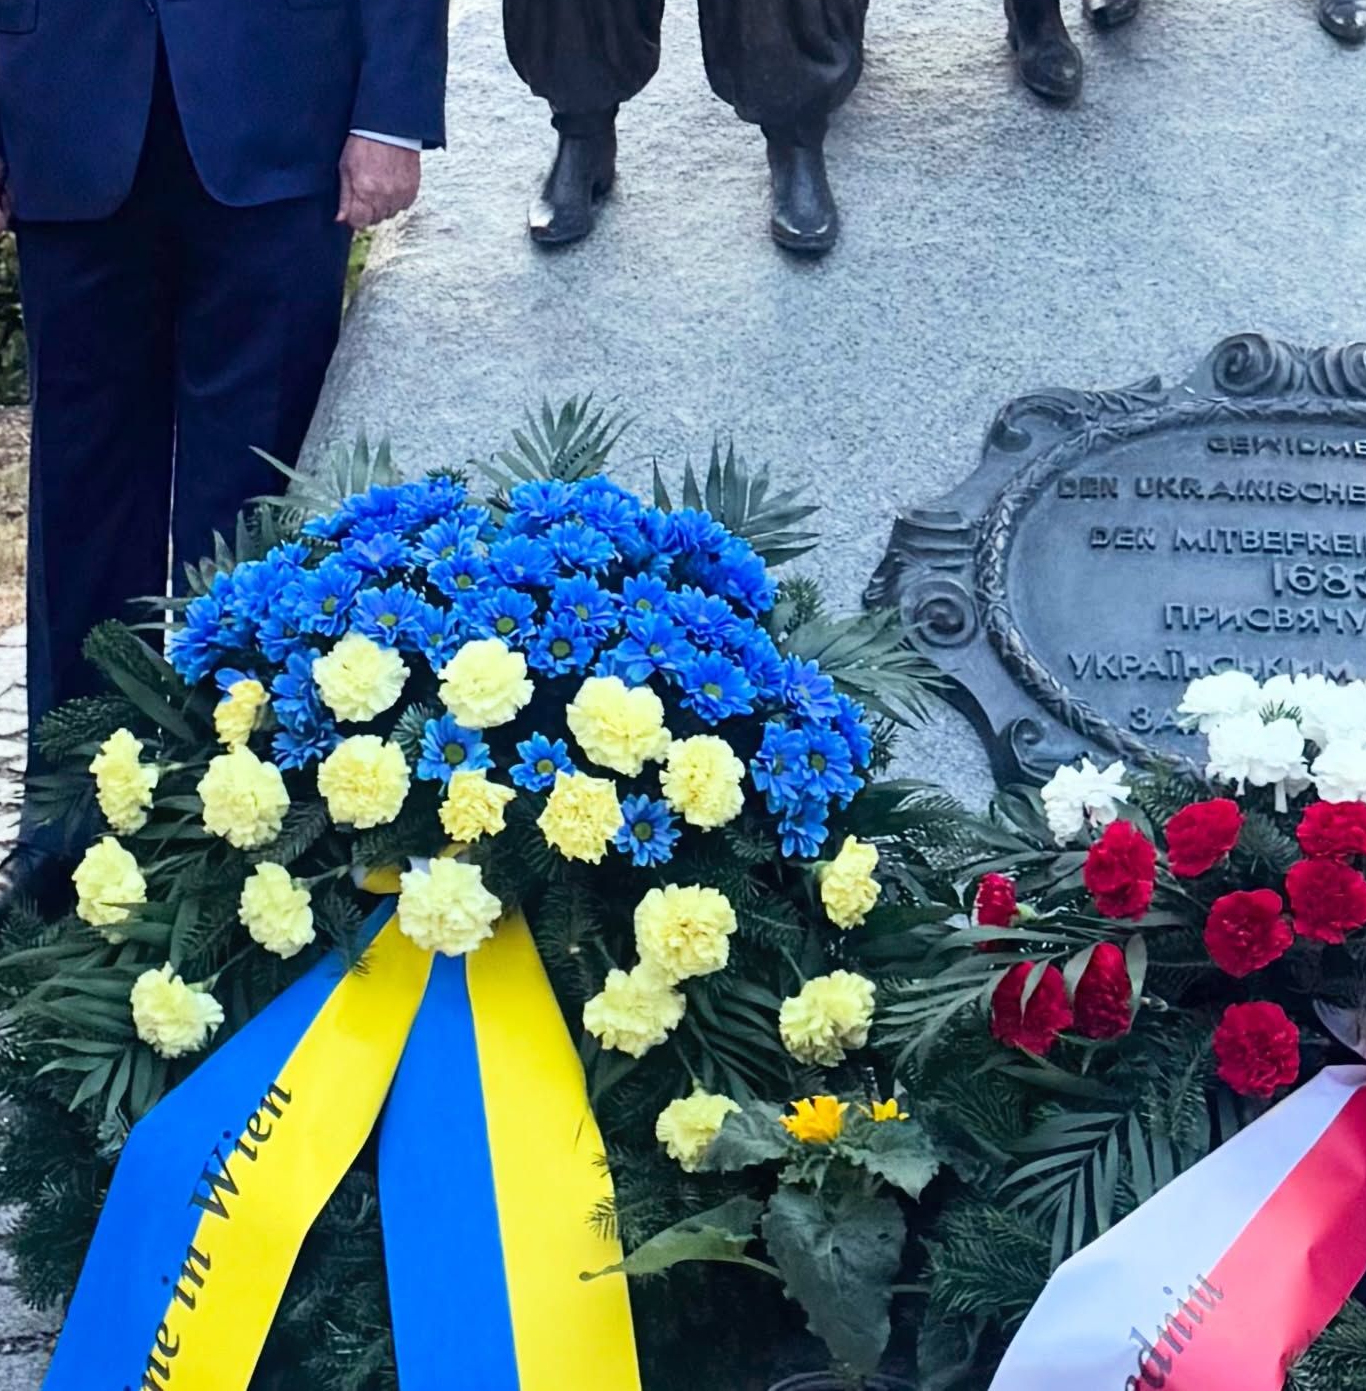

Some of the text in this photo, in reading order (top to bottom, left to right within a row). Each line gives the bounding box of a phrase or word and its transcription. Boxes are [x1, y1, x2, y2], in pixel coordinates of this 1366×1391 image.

[1057, 476, 1119, 499] DEN
[1090, 526, 1157, 550] DEN
[161, 1244, 212, 1311] in
[187, 1082, 292, 1220] Wien
